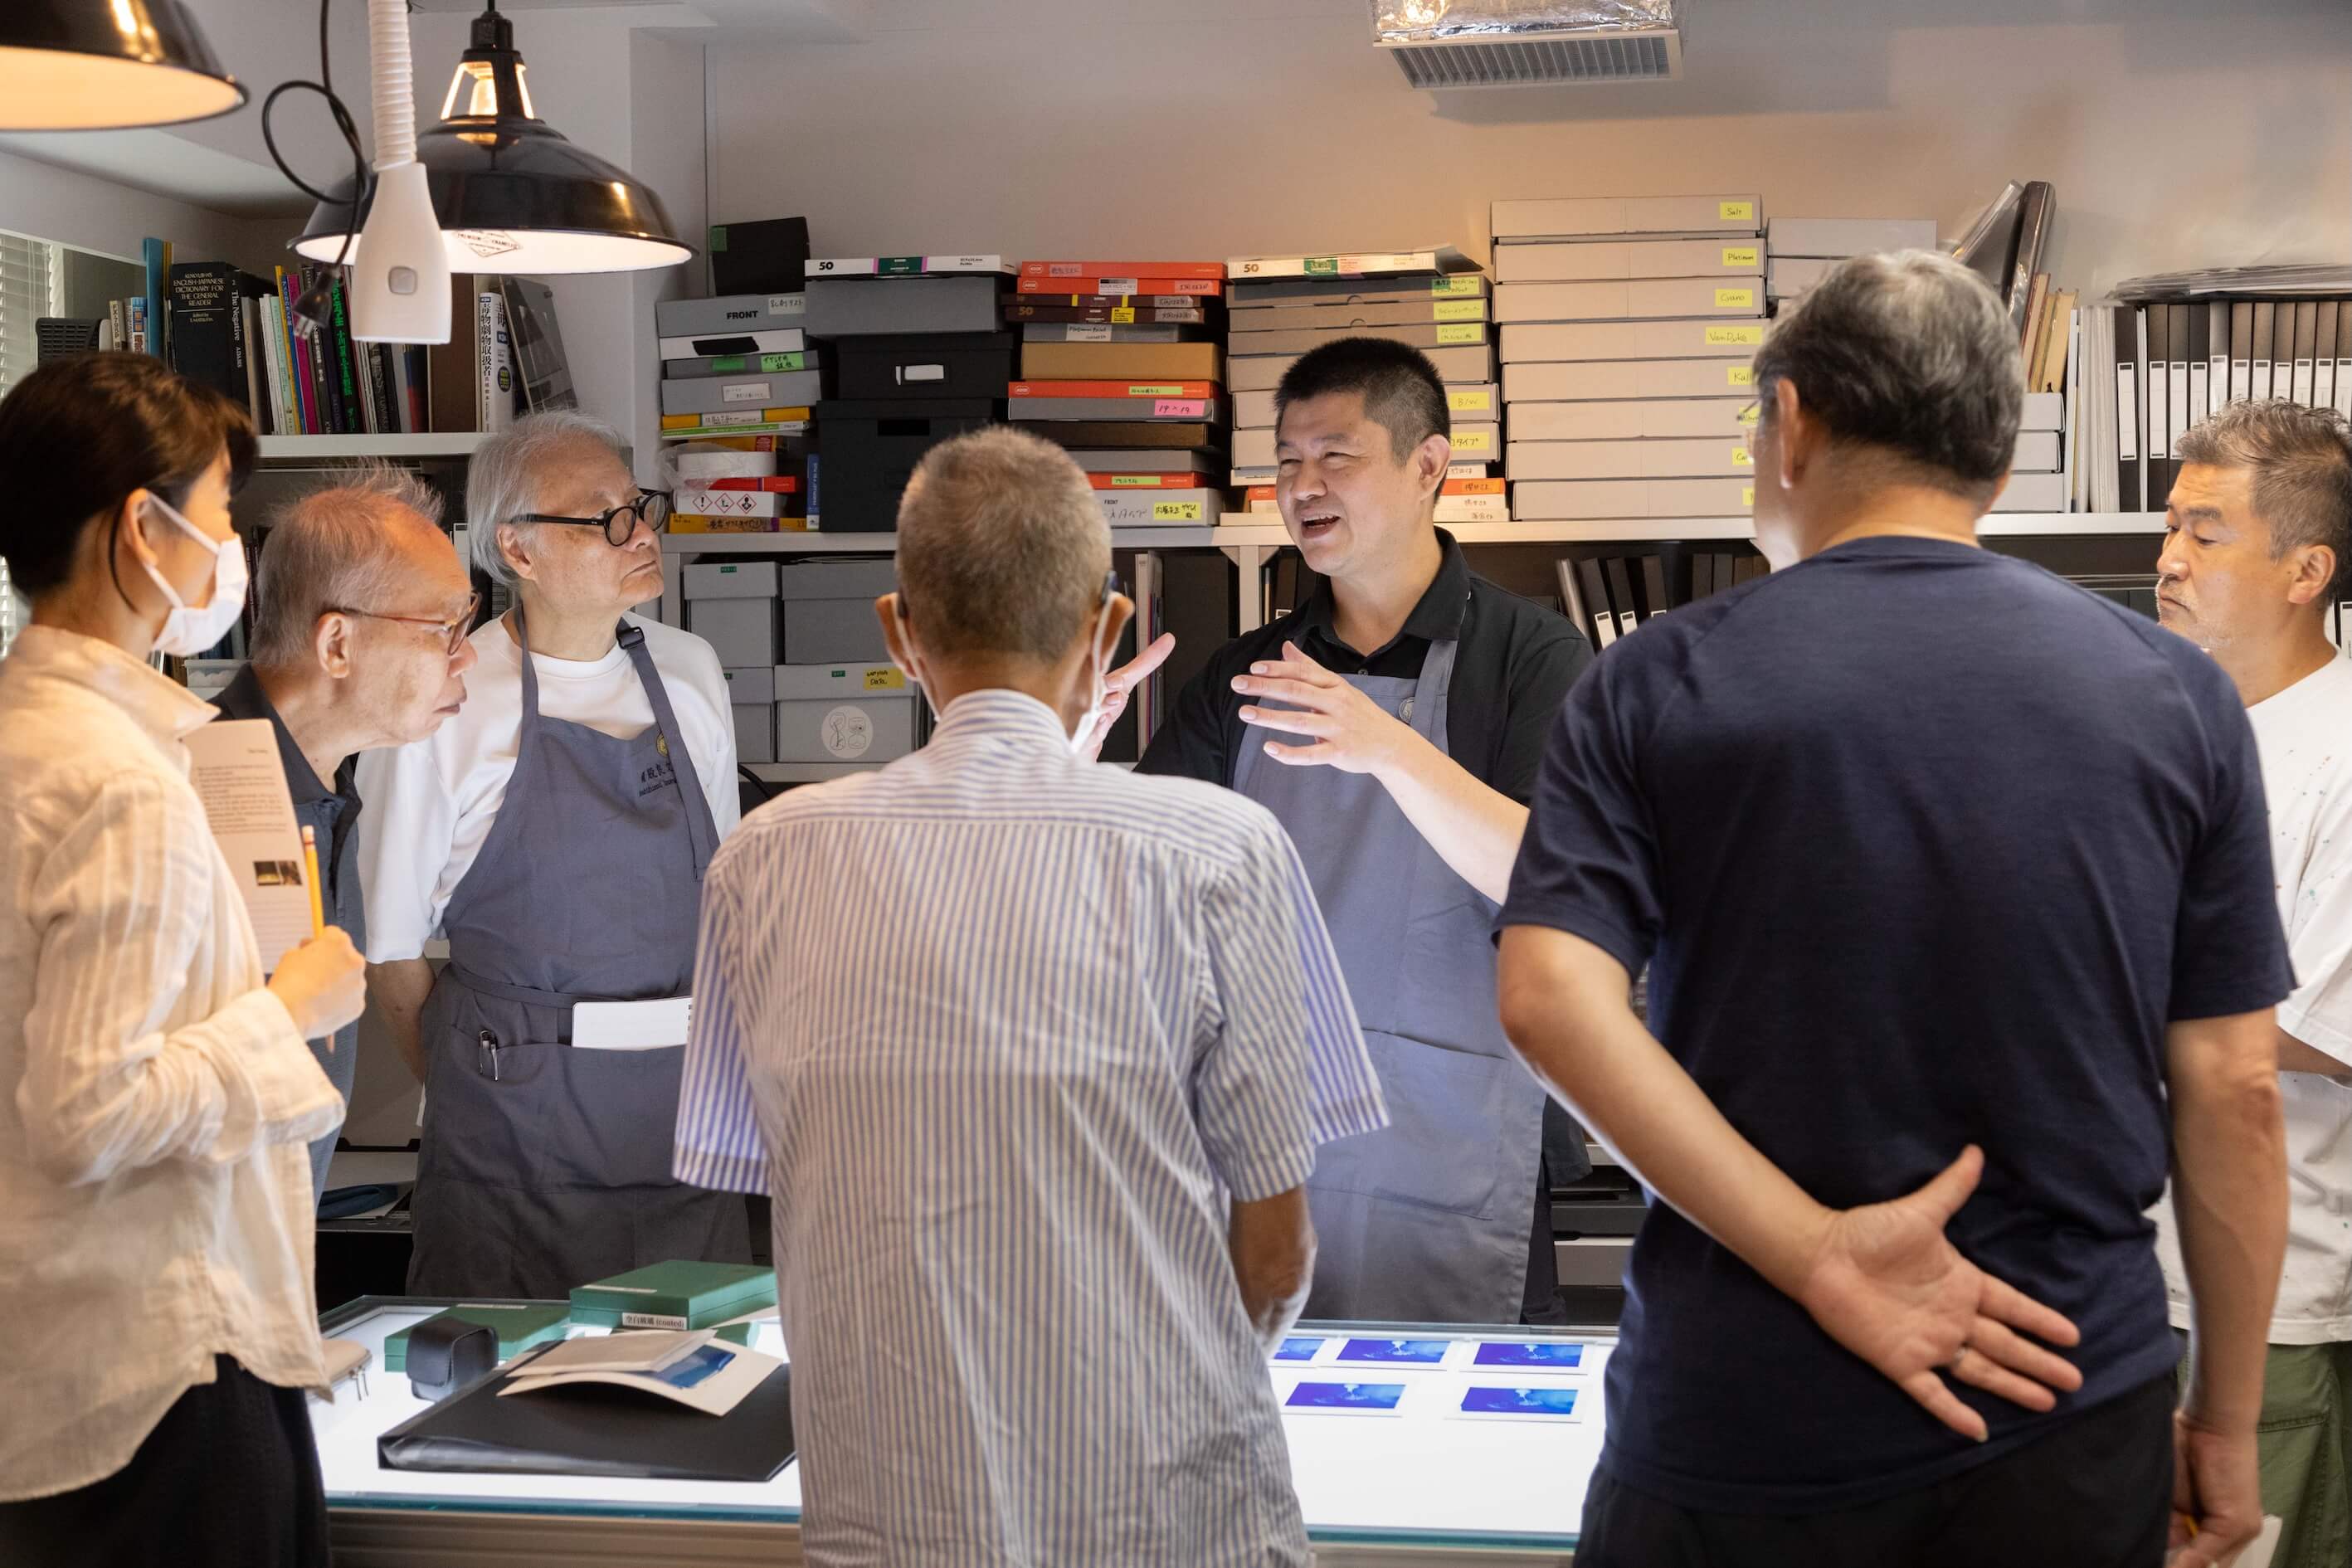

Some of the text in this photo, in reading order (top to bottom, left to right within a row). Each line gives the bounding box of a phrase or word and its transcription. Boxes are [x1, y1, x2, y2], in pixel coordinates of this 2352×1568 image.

[819, 261, 834, 270] 50
[1244, 264, 1259, 273] 50
[231, 290, 240, 304] The
[726, 310, 759, 320] FRONT
[1018, 306, 1034, 316] 50
[231, 304, 241, 341] Negative
[481, 303, 492, 377] 毒物劇物取扱者
